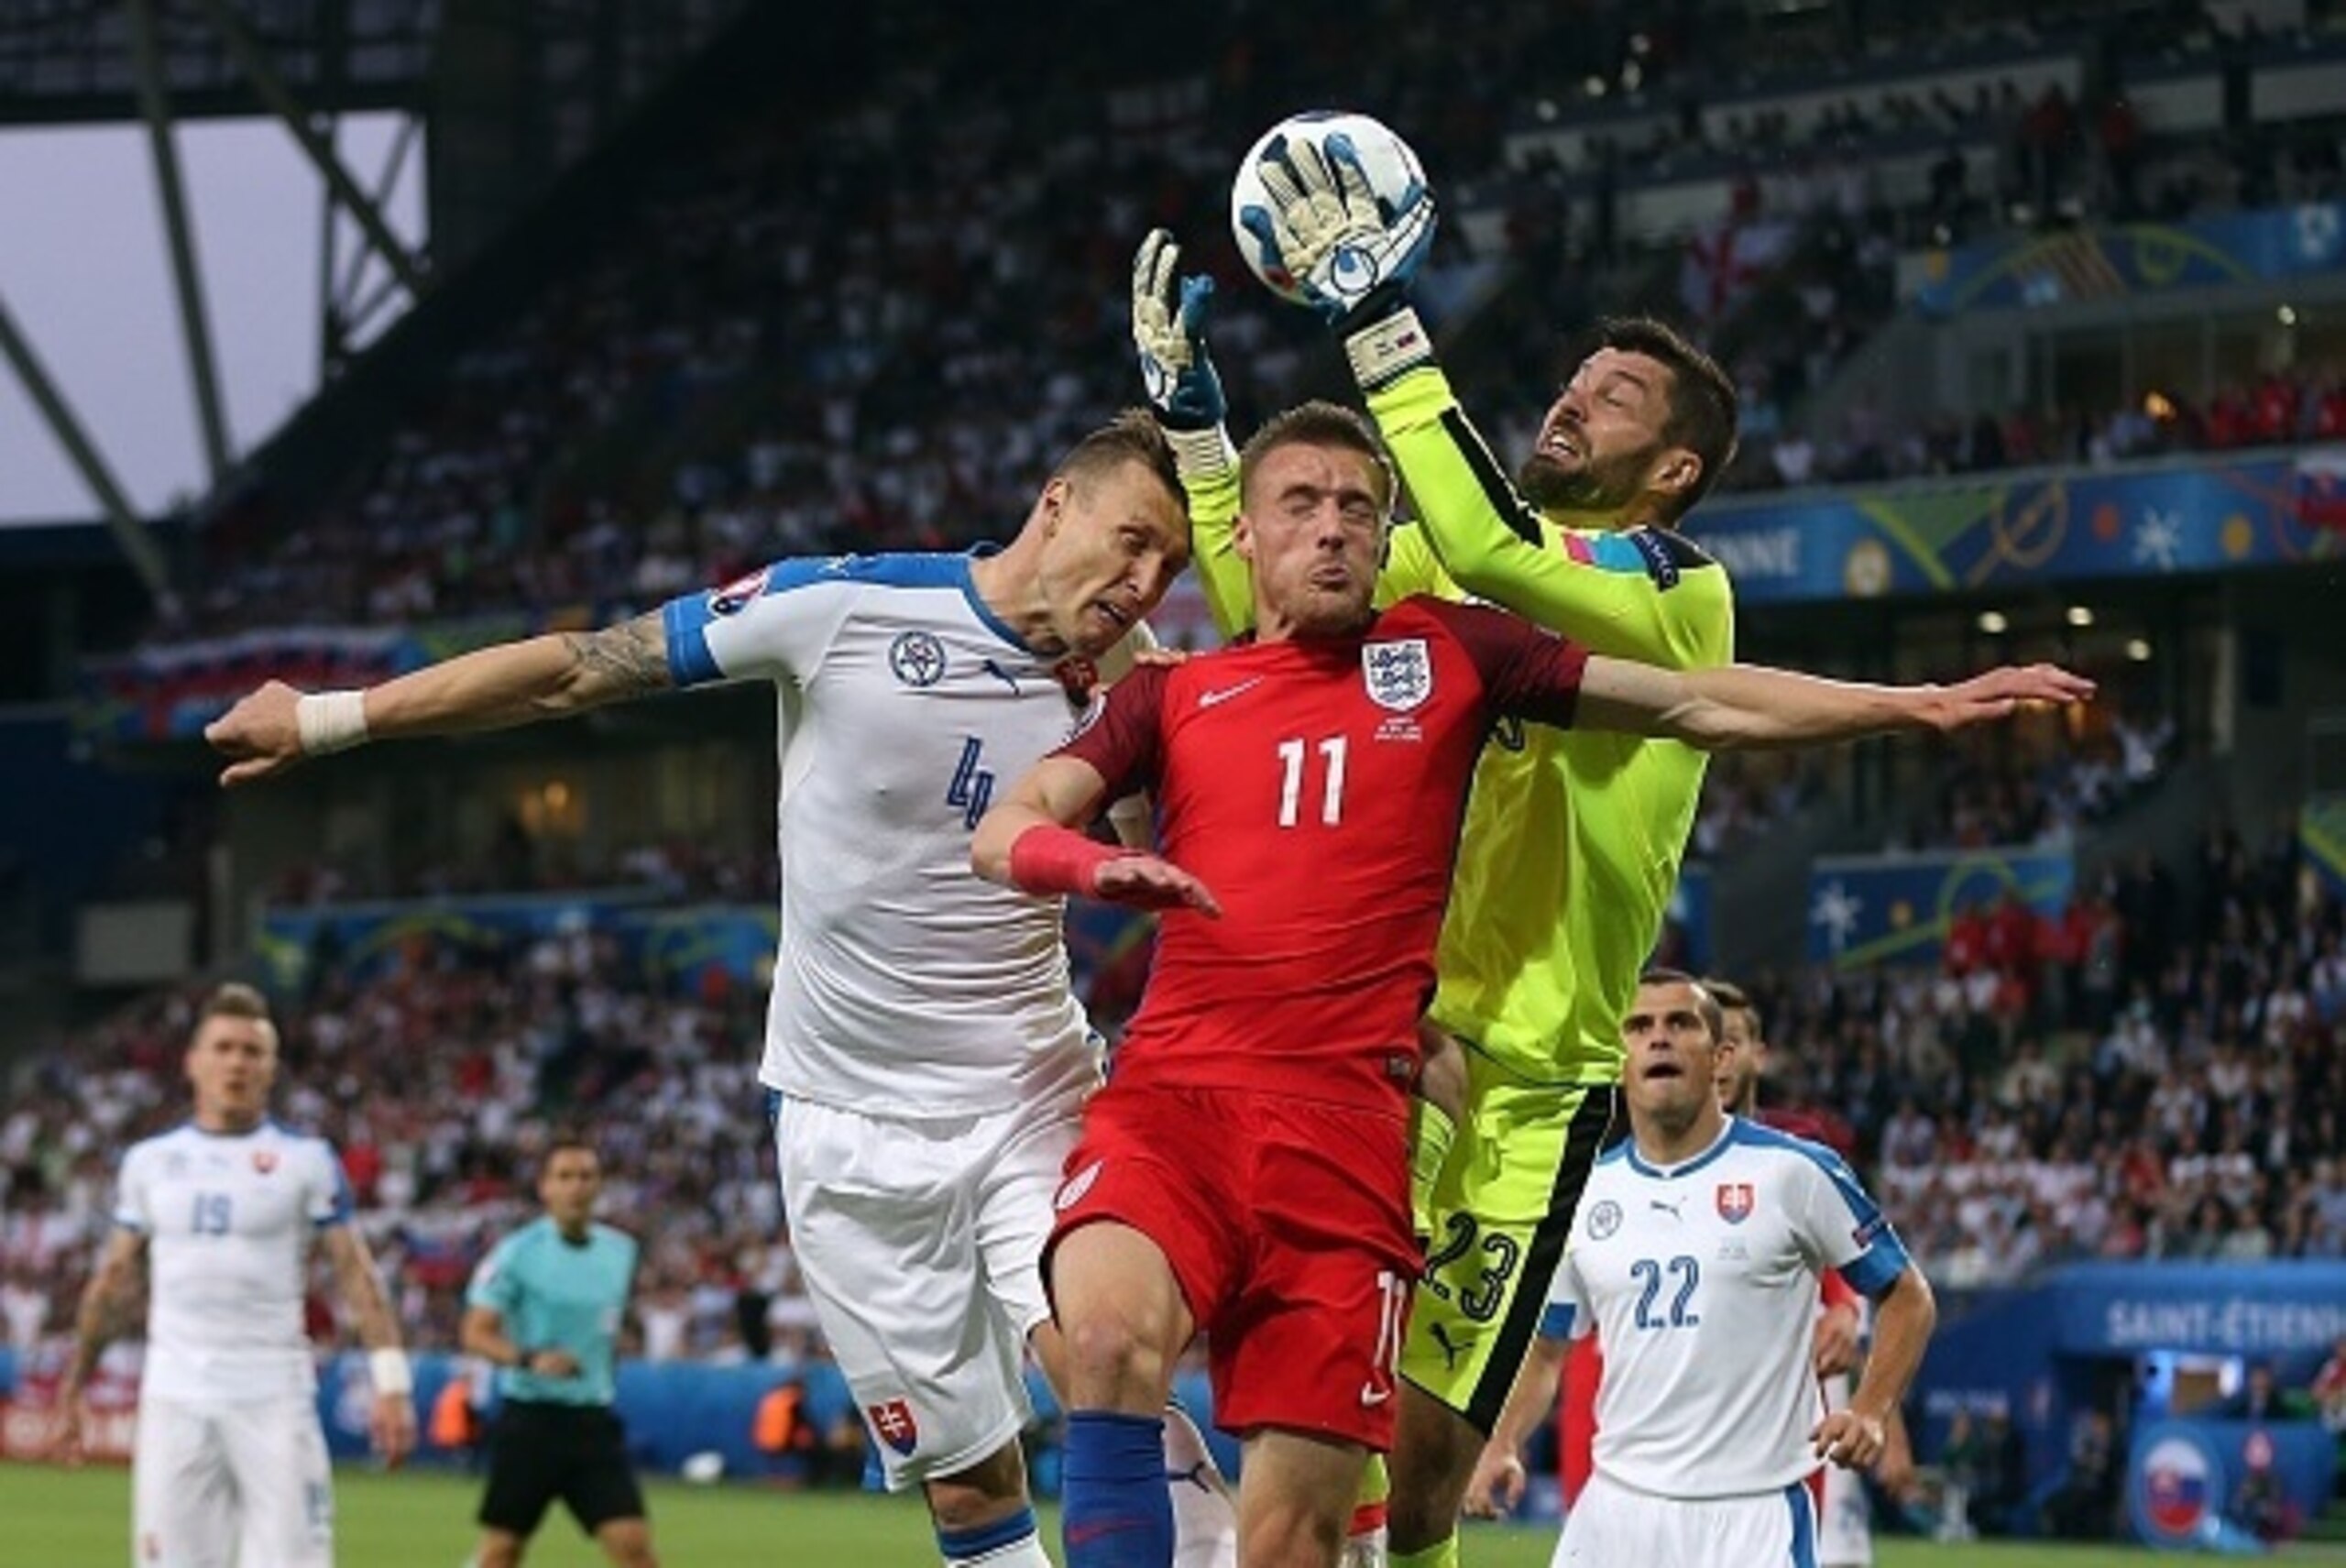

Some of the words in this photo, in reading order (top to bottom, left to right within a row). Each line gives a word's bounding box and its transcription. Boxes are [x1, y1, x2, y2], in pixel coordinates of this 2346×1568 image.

[947, 735, 995, 830] 4
[1278, 736, 1347, 826] 11
[192, 1193, 232, 1237] 19
[1422, 1212, 1518, 1322] 23
[1630, 1255, 1700, 1330] 22
